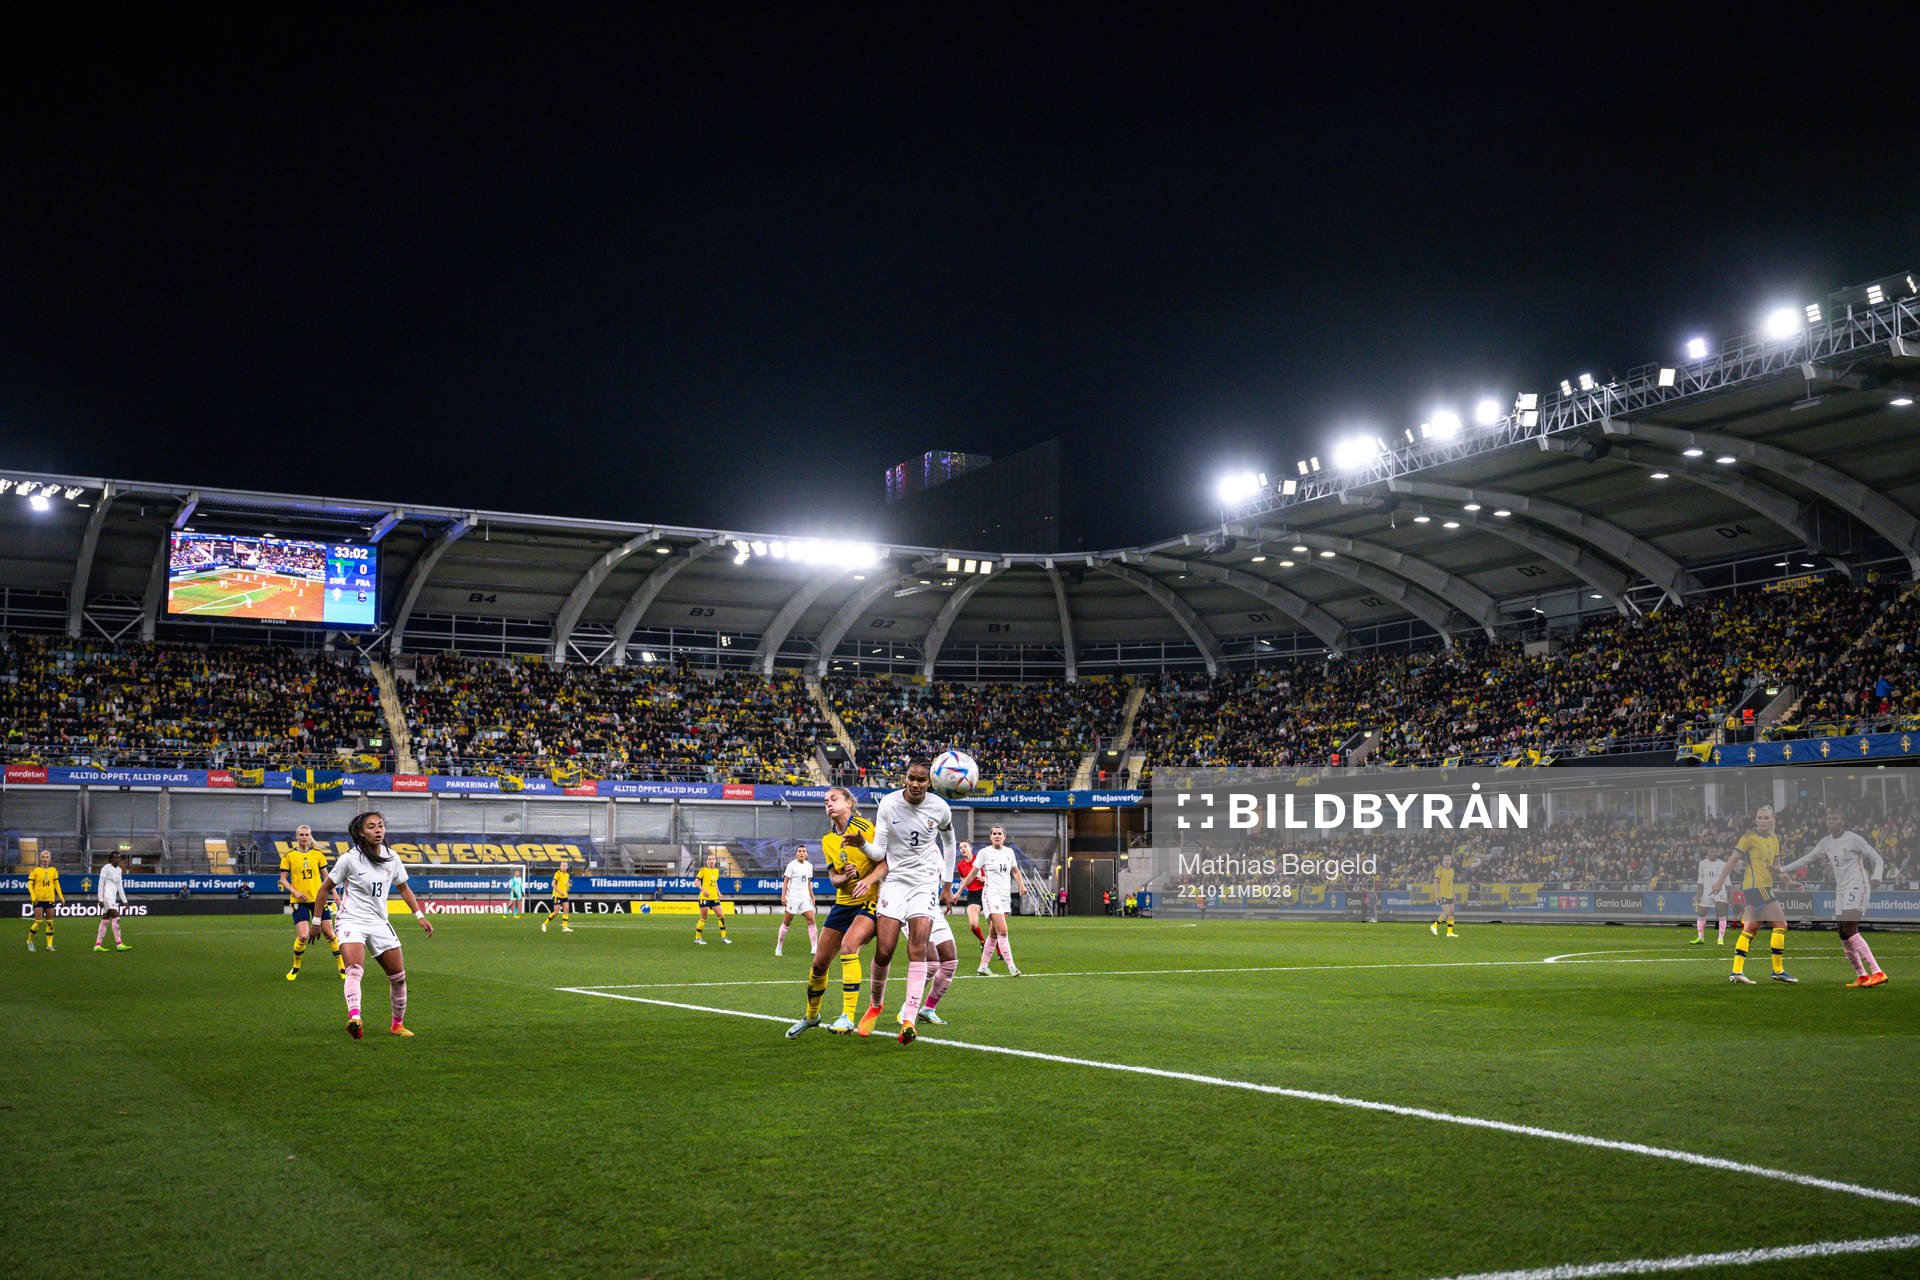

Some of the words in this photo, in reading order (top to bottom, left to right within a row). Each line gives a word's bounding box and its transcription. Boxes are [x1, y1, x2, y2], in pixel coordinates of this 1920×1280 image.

[1715, 524, 1752, 539] D4
[334, 546, 368, 559] 33:02
[335, 562, 341, 573] 1
[360, 564, 368, 575] 0
[1517, 565, 1547, 578] D3
[355, 579, 370, 587] FRA
[468, 592, 497, 604] B4
[1360, 596, 1387, 608] D2
[689, 607, 716, 617] B3
[1247, 613, 1273, 623] D1
[869, 619, 896, 628] B2
[987, 623, 1010, 632] B1
[9, 770, 45, 778] nordstan
[69, 771, 99, 779] ALLTID
[132, 773, 161, 781] ALLTID
[163, 774, 189, 782] PLATS
[395, 779, 426, 787] nordstan
[446, 781, 488, 789] PARKERING
[613, 785, 637, 793] ALLTID
[638, 785, 662, 795] ÖPPET,
[664, 786, 686, 794] ALLTID
[687, 787, 708, 795] PLATS
[1001, 794, 1009, 802] är
[1019, 794, 1050, 803] Sverige
[910, 831, 919, 847] 3
[391, 843, 586, 863] SVERIGE!
[1834, 856, 1840, 867] 5
[1000, 864, 1007, 873] 14
[302, 869, 313, 879] 13
[121, 879, 187, 888] illsammans
[189, 879, 200, 888] är
[202, 880, 212, 888] vi
[428, 880, 489, 889] Tillsammans
[490, 880, 501, 889] är
[591, 878, 655, 888] Tillsammans
[657, 878, 667, 888] är
[669, 878, 679, 887] vi
[372, 882, 383, 898] 13
[1848, 892, 1856, 902] 5
[1596, 899, 1619, 908] Gamla
[1621, 899, 1642, 908] Ullevi
[1786, 899, 1812, 909] Ullevi
